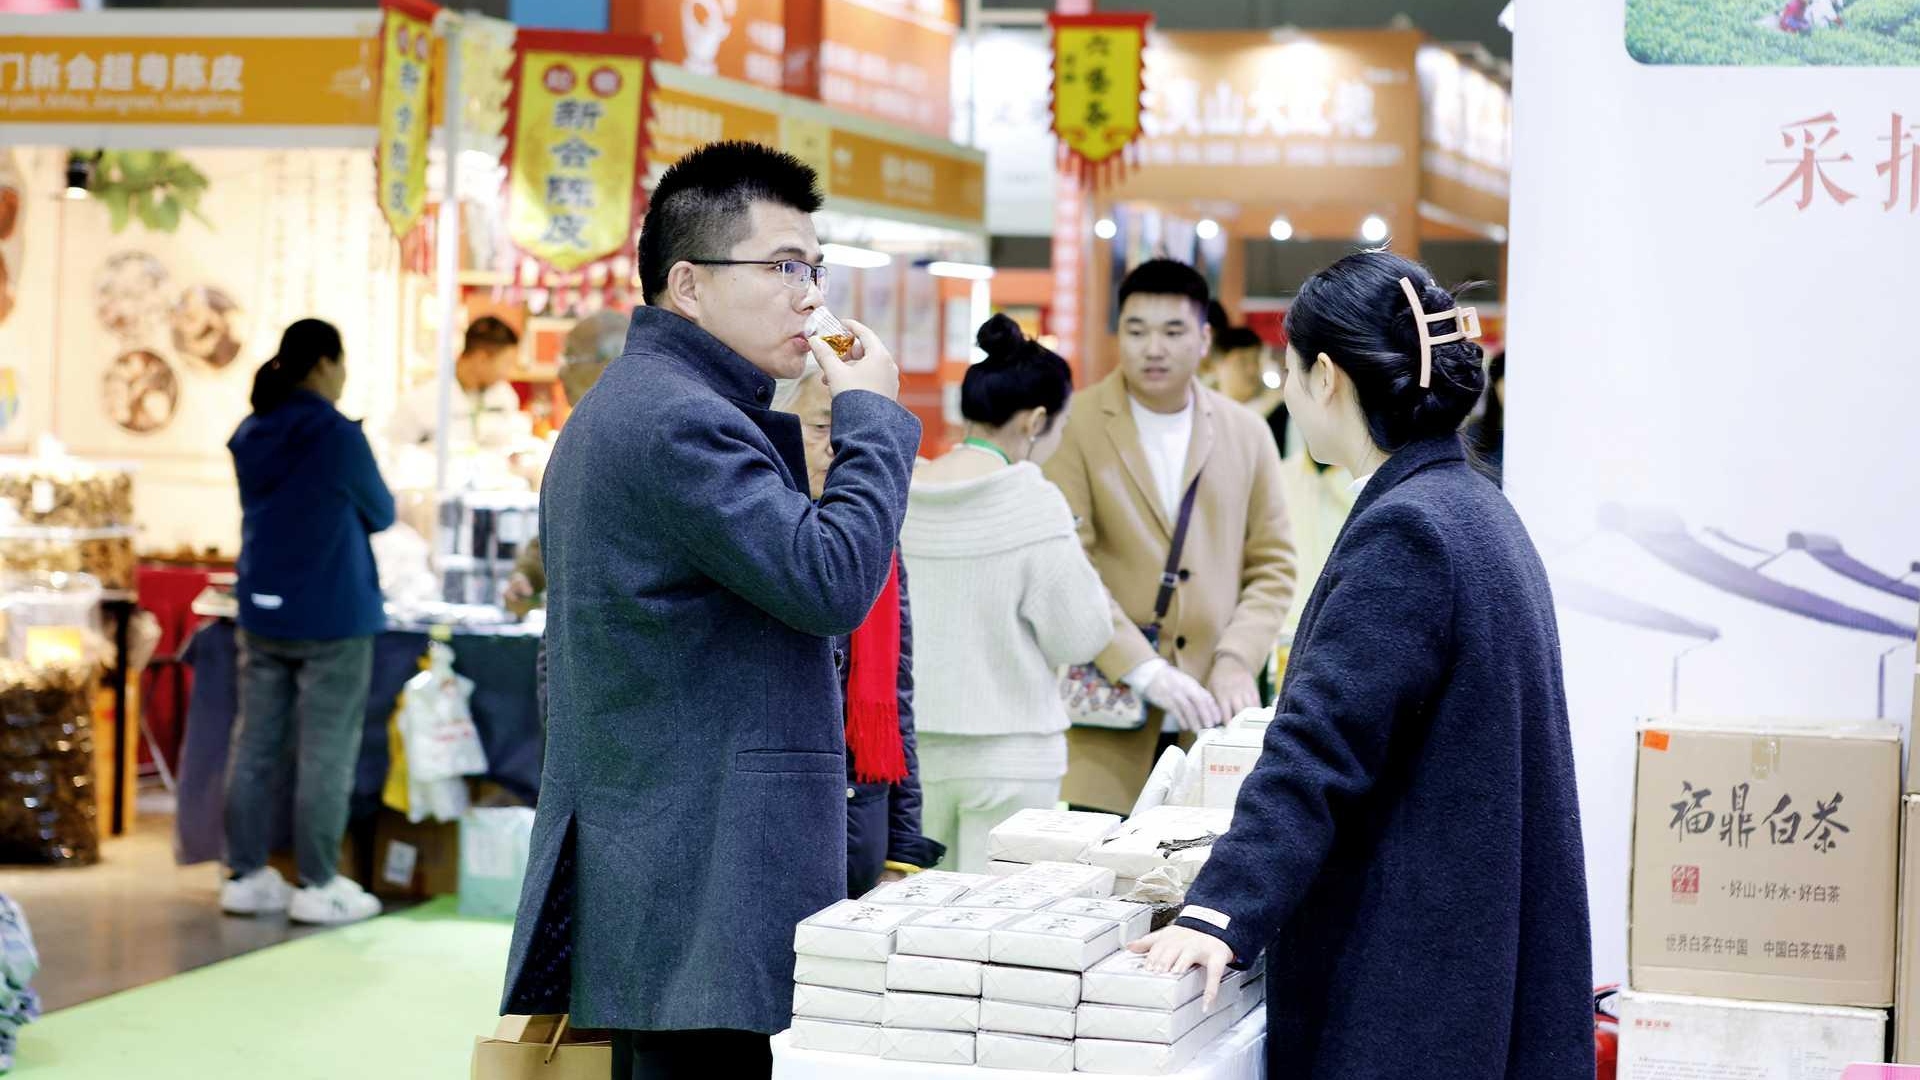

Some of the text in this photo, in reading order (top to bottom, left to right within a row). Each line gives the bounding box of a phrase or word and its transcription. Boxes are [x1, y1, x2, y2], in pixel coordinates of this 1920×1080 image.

[542, 98, 605, 248] 新会陈皮
[1669, 780, 1850, 854] 福鼎白茶
[1665, 933, 1847, 962] 世界白茶在中国 中国白茶在福鼎
